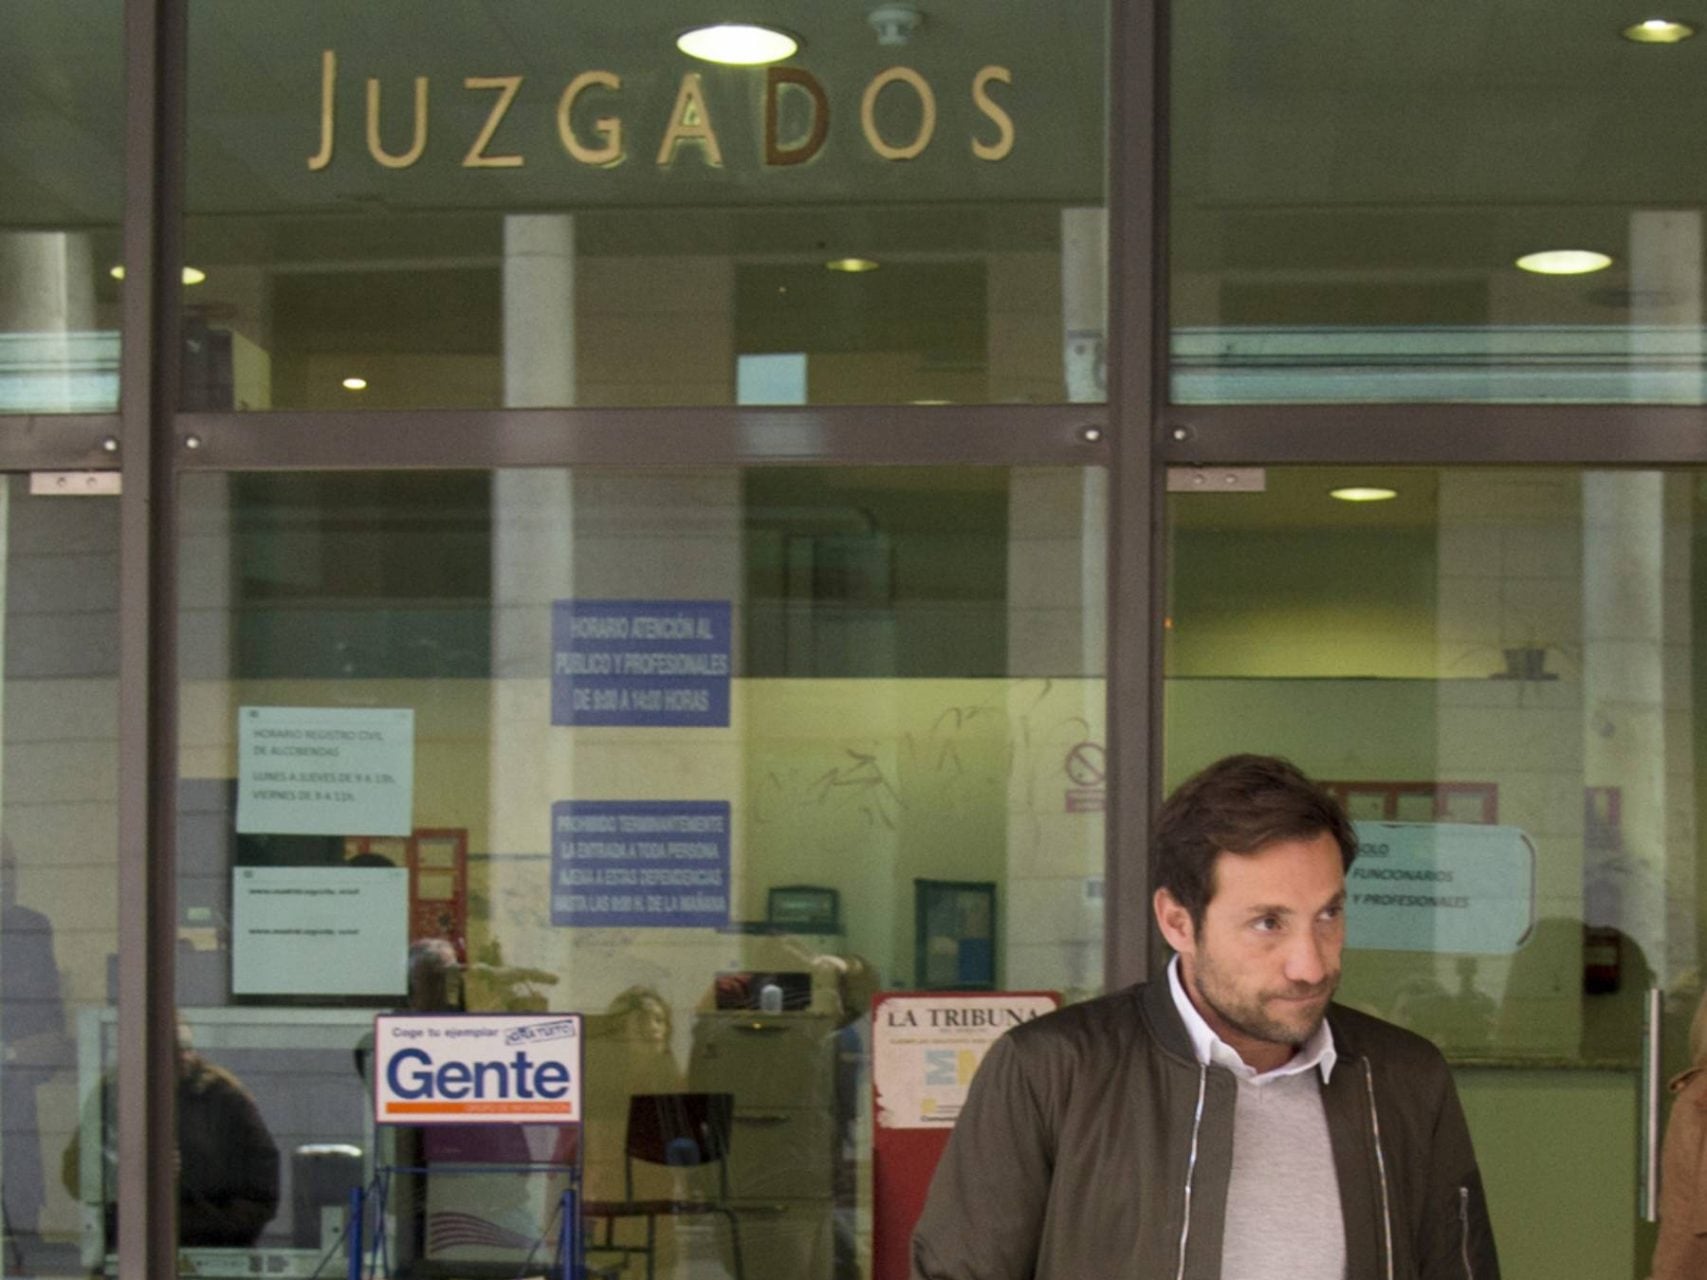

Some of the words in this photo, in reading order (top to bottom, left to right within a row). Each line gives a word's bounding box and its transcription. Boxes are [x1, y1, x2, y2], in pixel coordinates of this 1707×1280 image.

[308, 50, 1014, 169] JUZGADOS
[571, 617, 629, 640] HORARIO
[613, 652, 624, 675] Y
[624, 652, 728, 676] PROFESIONALES
[573, 687, 592, 711] DE
[619, 688, 630, 711] A
[665, 688, 710, 712] HORAS
[253, 728, 300, 739] HORARIO
[305, 729, 355, 740] REGISTRO
[253, 745, 267, 756] DE
[271, 746, 340, 757] ALCOBENDAS
[252, 771, 287, 782] LUNES
[289, 772, 296, 782] A
[297, 772, 337, 782] JUEVES
[338, 772, 351, 783] DE
[252, 789, 296, 800] VIERNES
[298, 790, 310, 800] DE
[667, 842, 720, 859] PERSONA
[1353, 868, 1454, 882] FUNCIONARIOS
[1353, 894, 1361, 905] Y
[1362, 894, 1470, 908] PROFESIONALES
[887, 1010, 917, 1027] LA
[392, 1027, 423, 1039] Coge
[428, 1027, 440, 1038] tu
[444, 1027, 498, 1039] ejemplar
[386, 1048, 570, 1099] Gente
